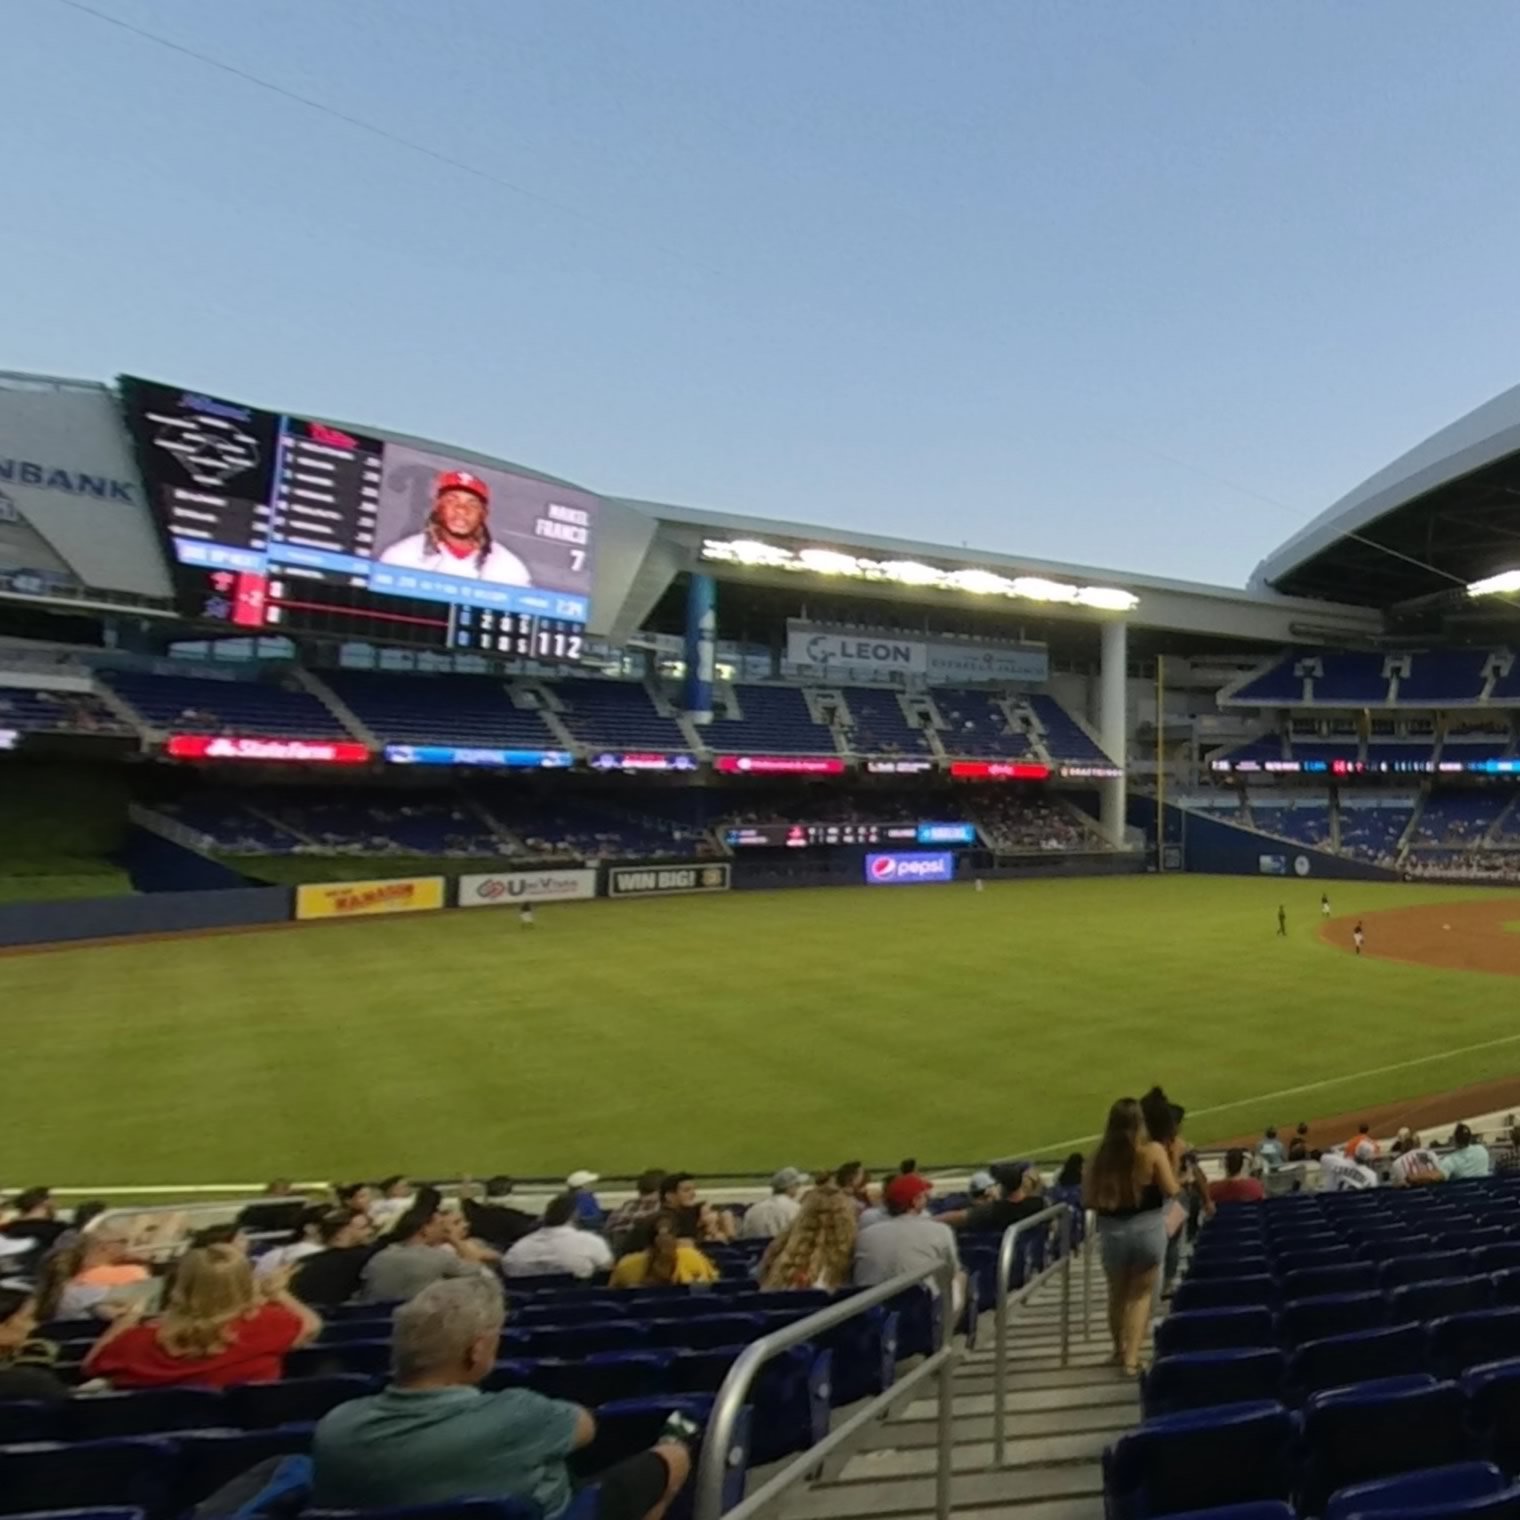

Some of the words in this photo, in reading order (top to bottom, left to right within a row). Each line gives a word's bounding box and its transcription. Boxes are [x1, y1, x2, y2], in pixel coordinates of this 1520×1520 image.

[569, 549, 586, 571] 7
[841, 641, 911, 663] LEON
[617, 870, 655, 891] WIN
[657, 867, 697, 888] BIG!
[897, 860, 945, 877] pepsi
